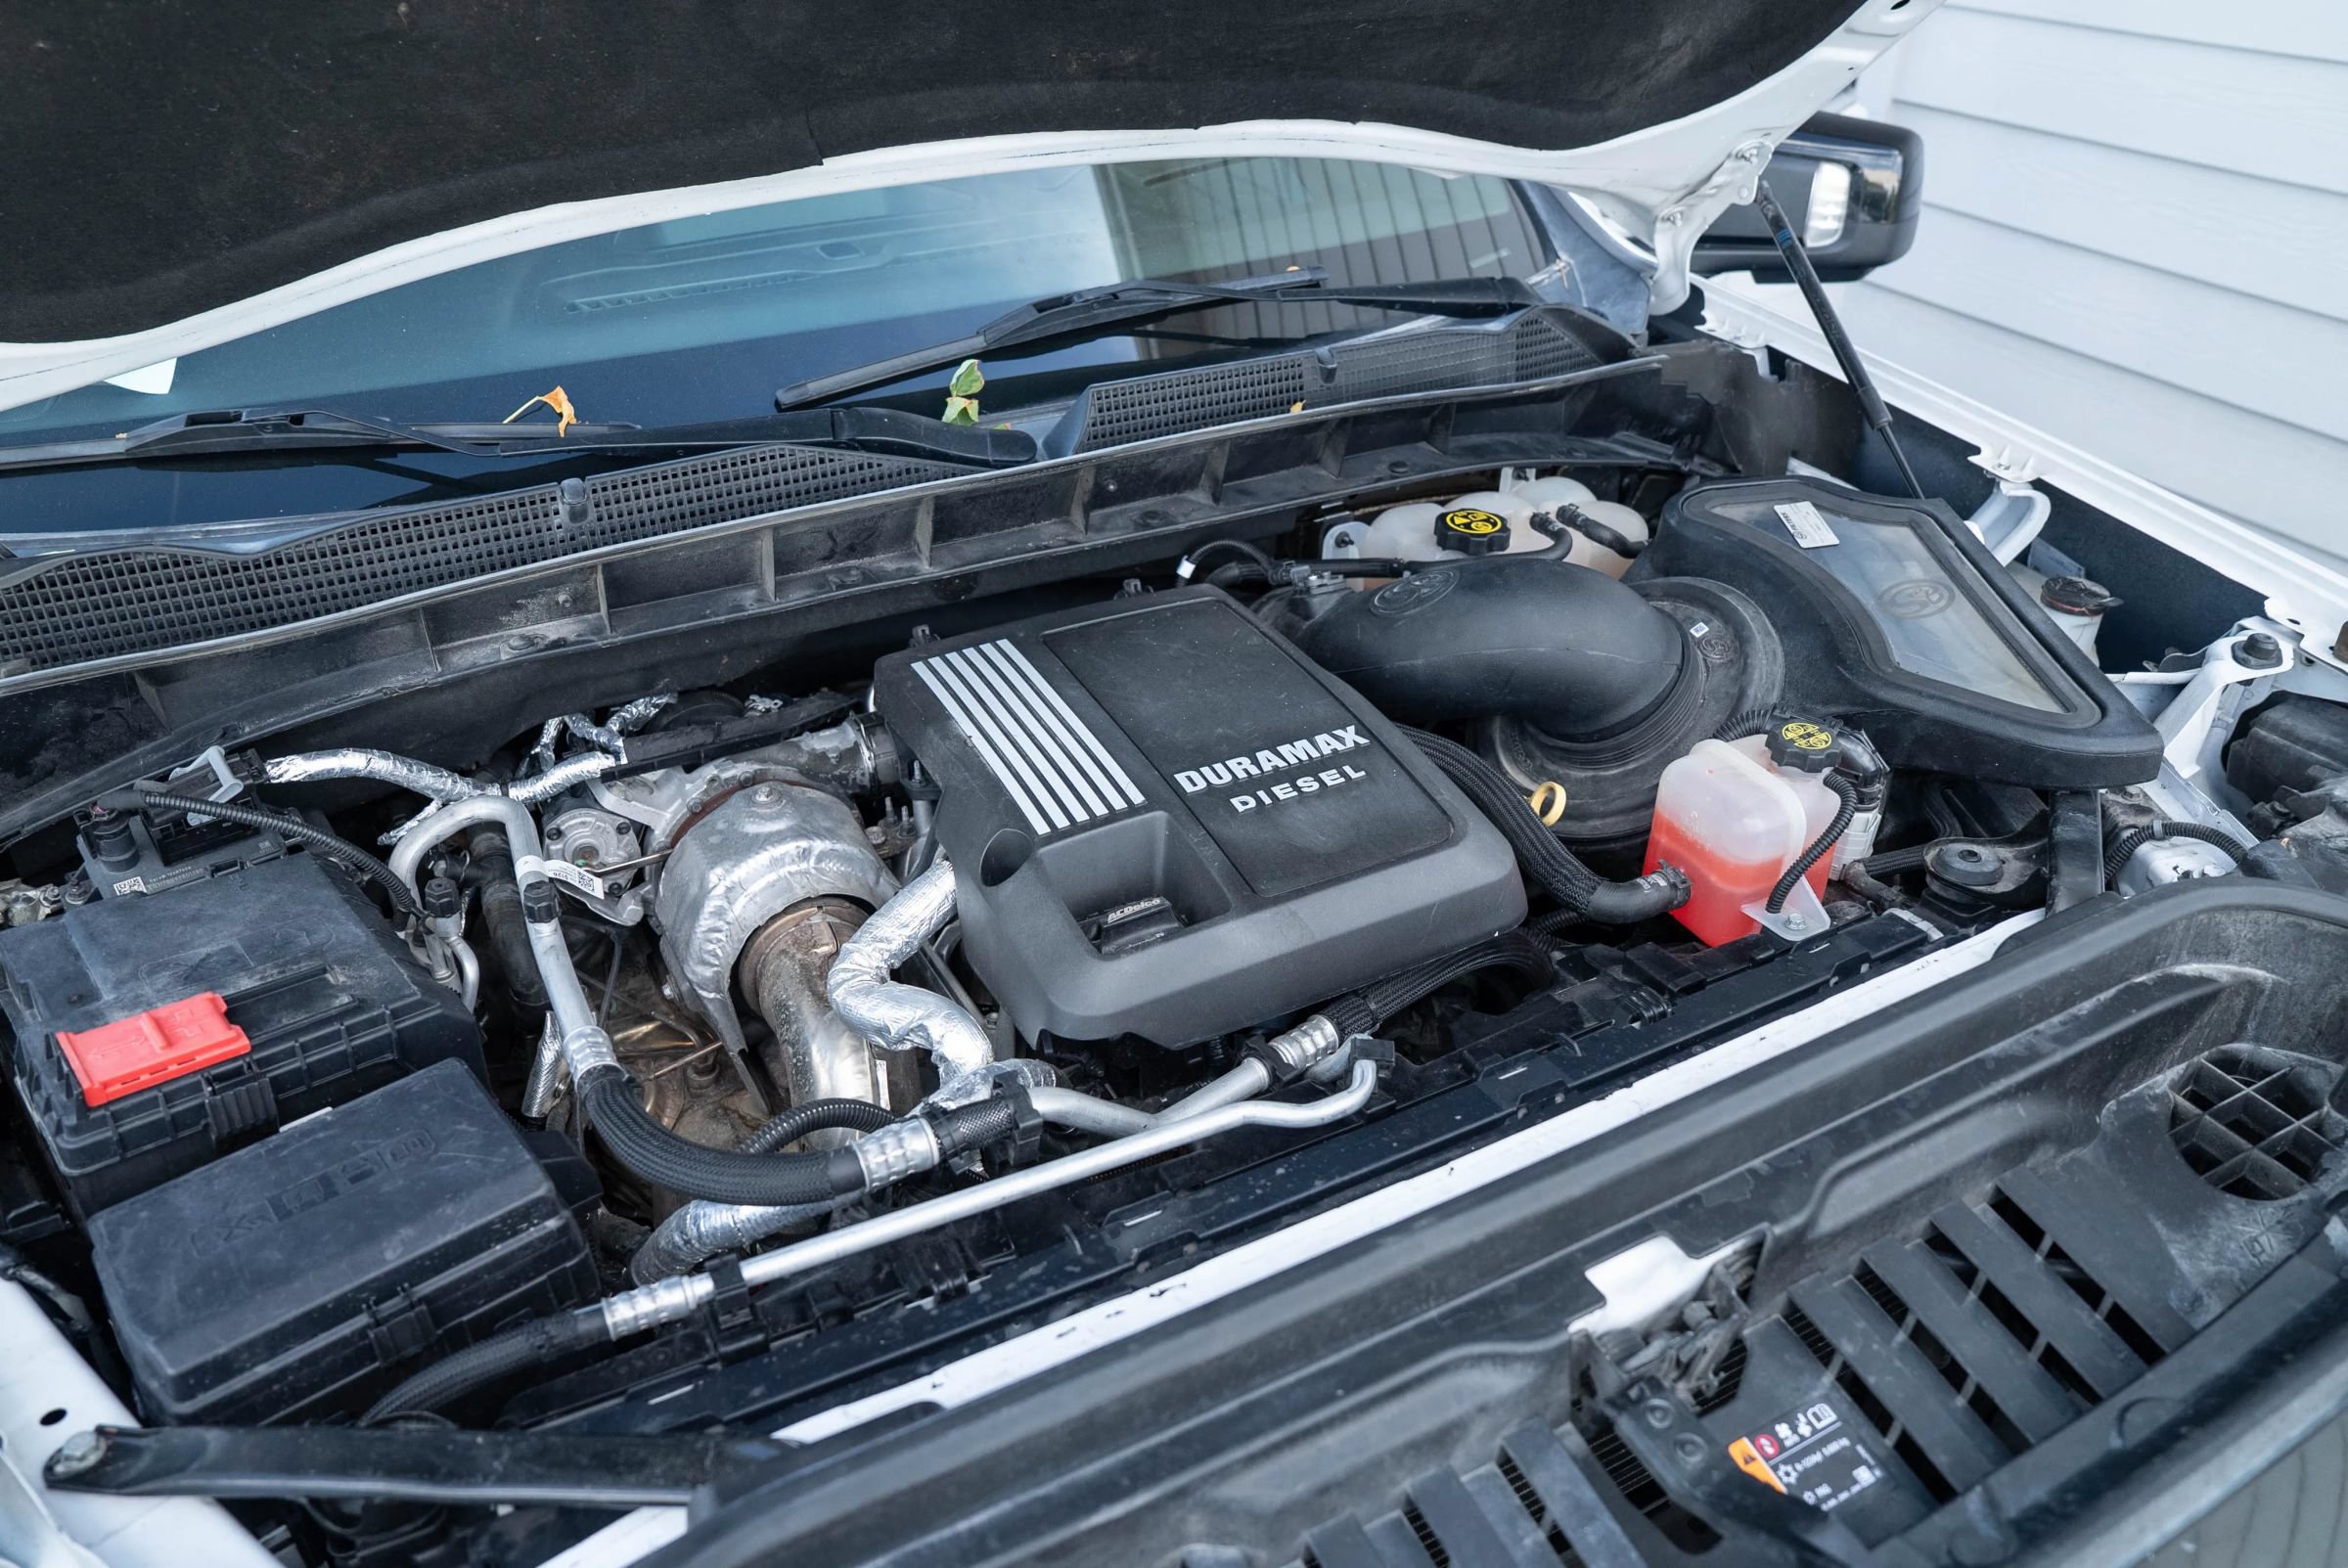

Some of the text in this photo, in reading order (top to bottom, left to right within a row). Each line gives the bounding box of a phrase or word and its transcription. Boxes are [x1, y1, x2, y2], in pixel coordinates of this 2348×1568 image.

[1174, 725, 1370, 794] DURAMAX
[1229, 764, 1367, 814] DIESEL
[1107, 898, 1160, 923] ACDelco
